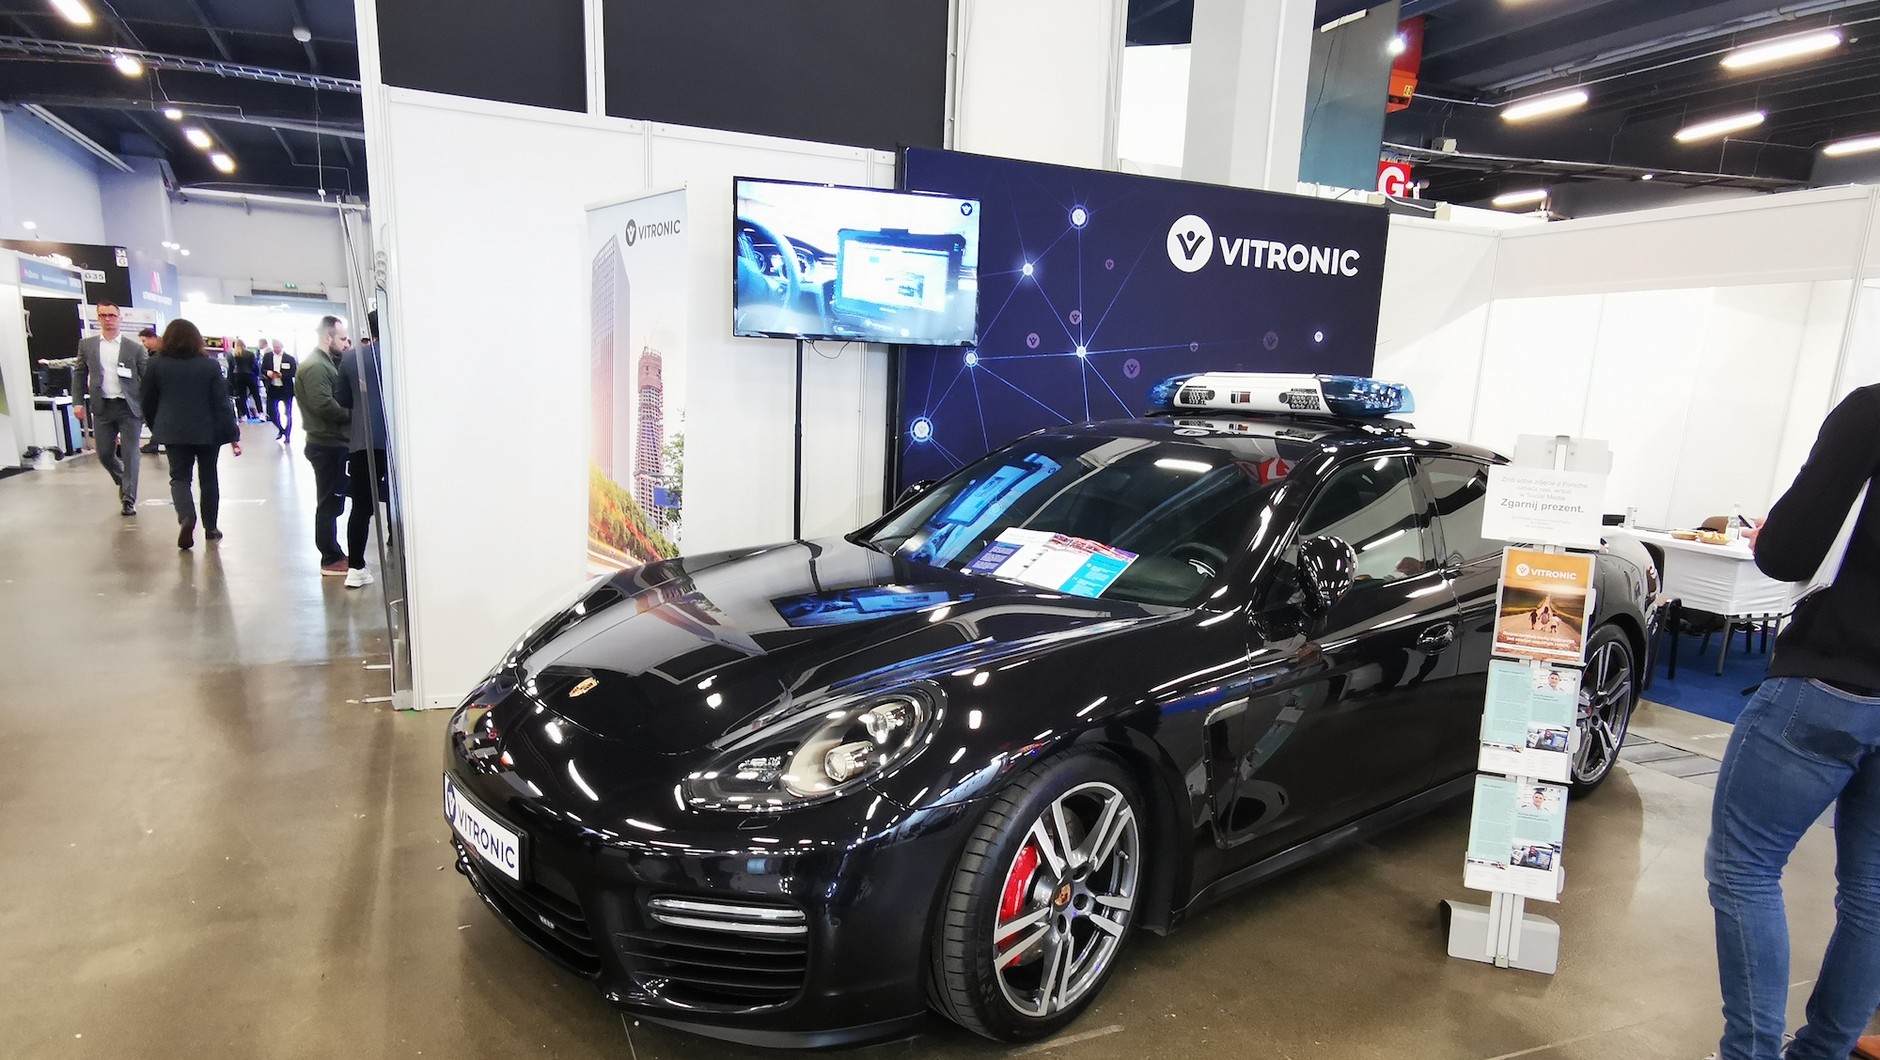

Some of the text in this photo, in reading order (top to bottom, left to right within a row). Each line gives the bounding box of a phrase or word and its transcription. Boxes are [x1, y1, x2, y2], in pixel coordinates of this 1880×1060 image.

[1378, 166, 1405, 198] G
[637, 218, 681, 241] VITRONIC
[1219, 236, 1360, 277] VITRONIC
[1500, 497, 1584, 513] Zgarnij prezent.
[1531, 568, 1576, 580] VITRONIC
[457, 804, 515, 869] VITRONIC
